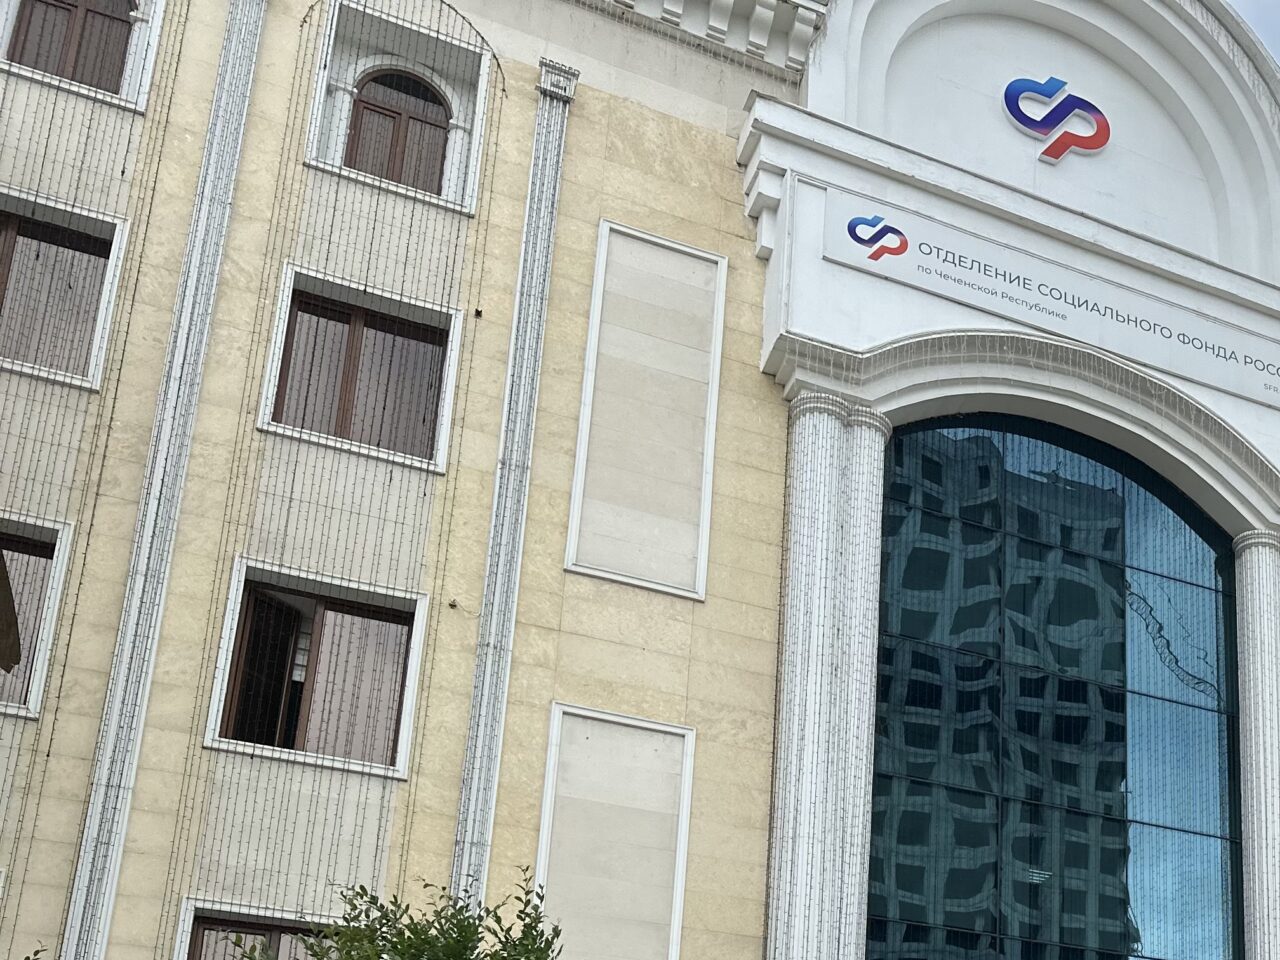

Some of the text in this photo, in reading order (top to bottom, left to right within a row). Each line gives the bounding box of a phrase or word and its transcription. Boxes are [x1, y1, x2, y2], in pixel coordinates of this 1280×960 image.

[917, 264, 1068, 321] по Чеченской Республике
[918, 242, 1033, 291] ОТДЕЛЕНИЕ
[1037, 283, 1173, 340] СОЦИАЛЬНОГО
[1176, 332, 1239, 364] ФОНДА
